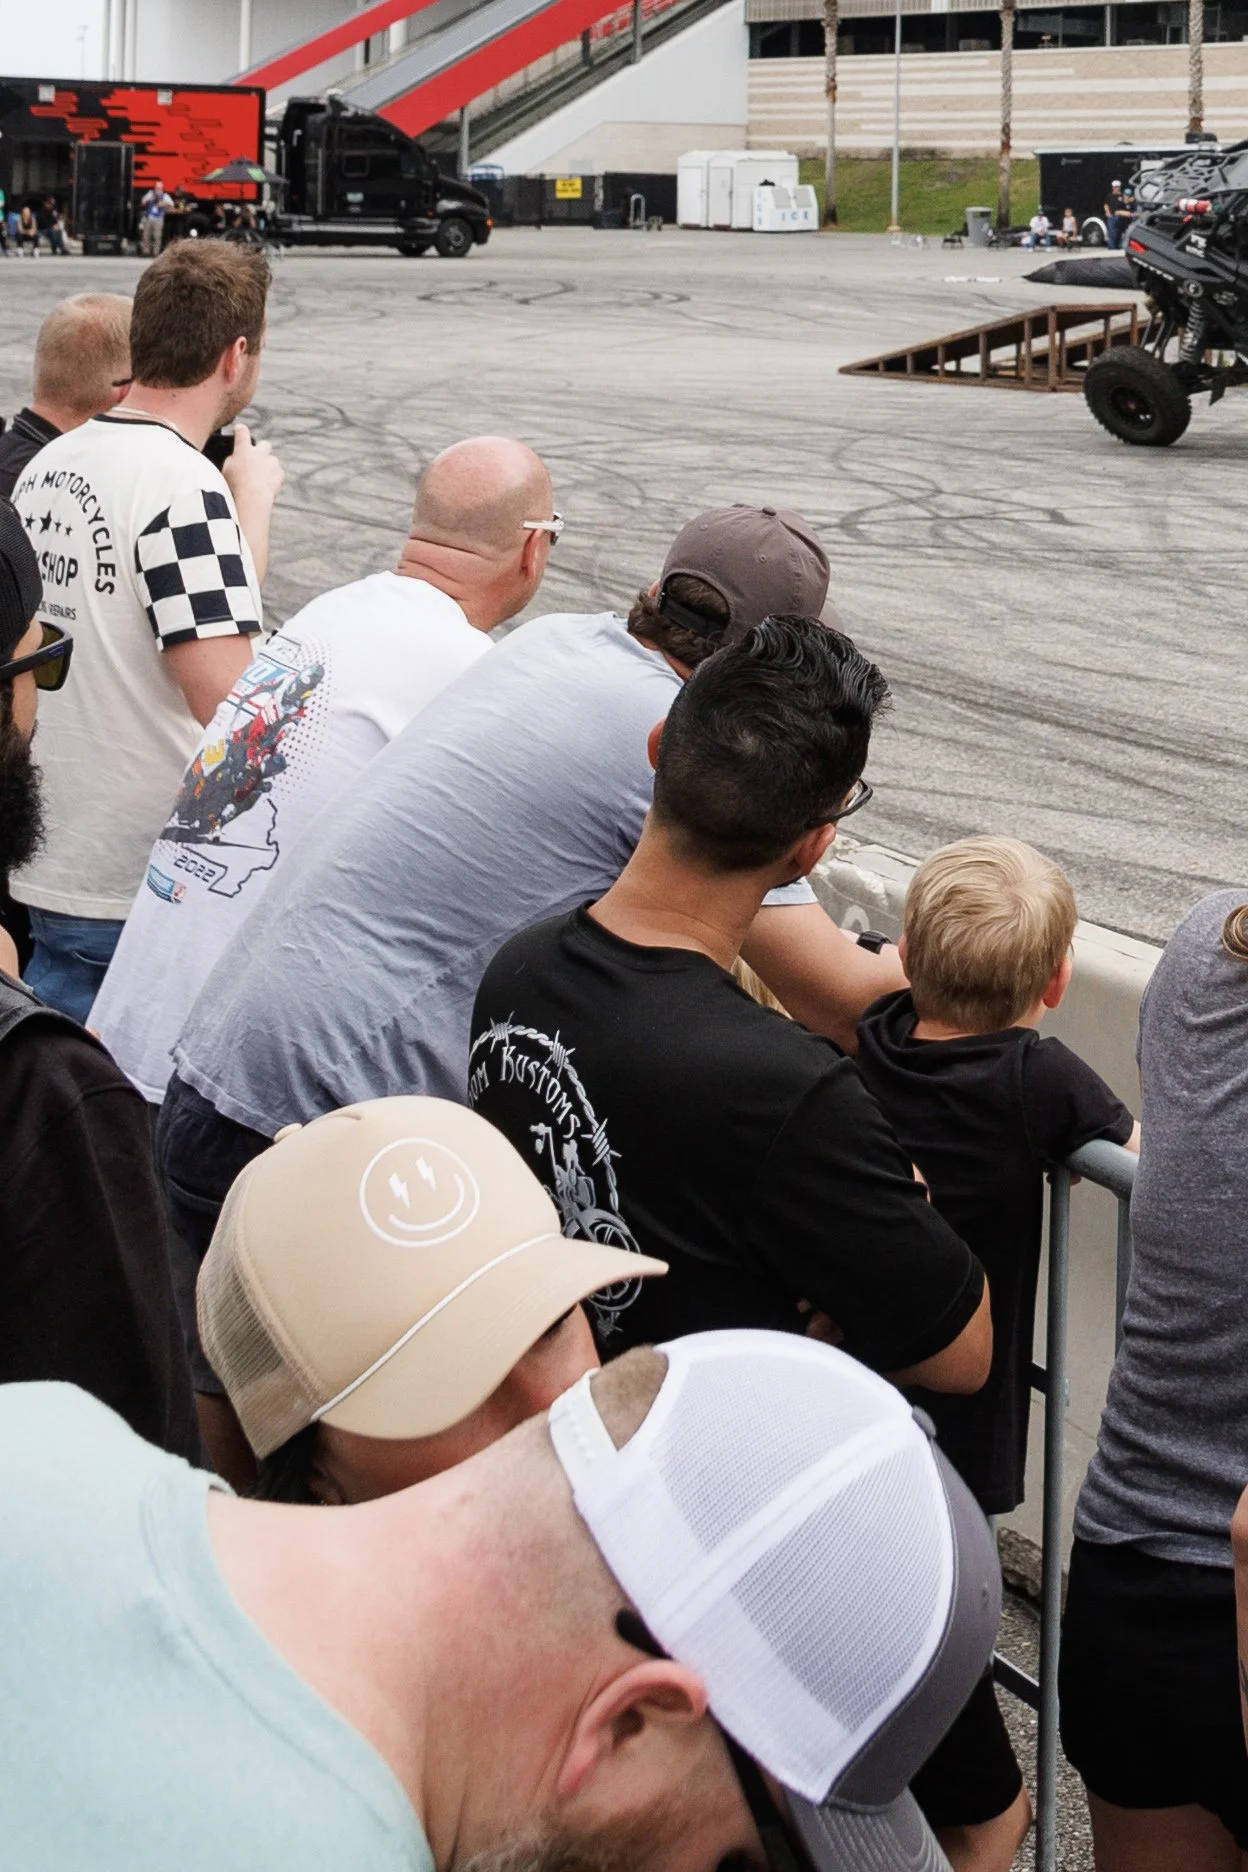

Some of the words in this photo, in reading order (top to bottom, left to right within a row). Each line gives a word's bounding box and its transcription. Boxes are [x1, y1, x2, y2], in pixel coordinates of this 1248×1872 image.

[40, 470, 117, 595] MOTORCYCLES
[173, 853, 217, 883] 2022
[500, 1045, 582, 1140] KUSTOMS
